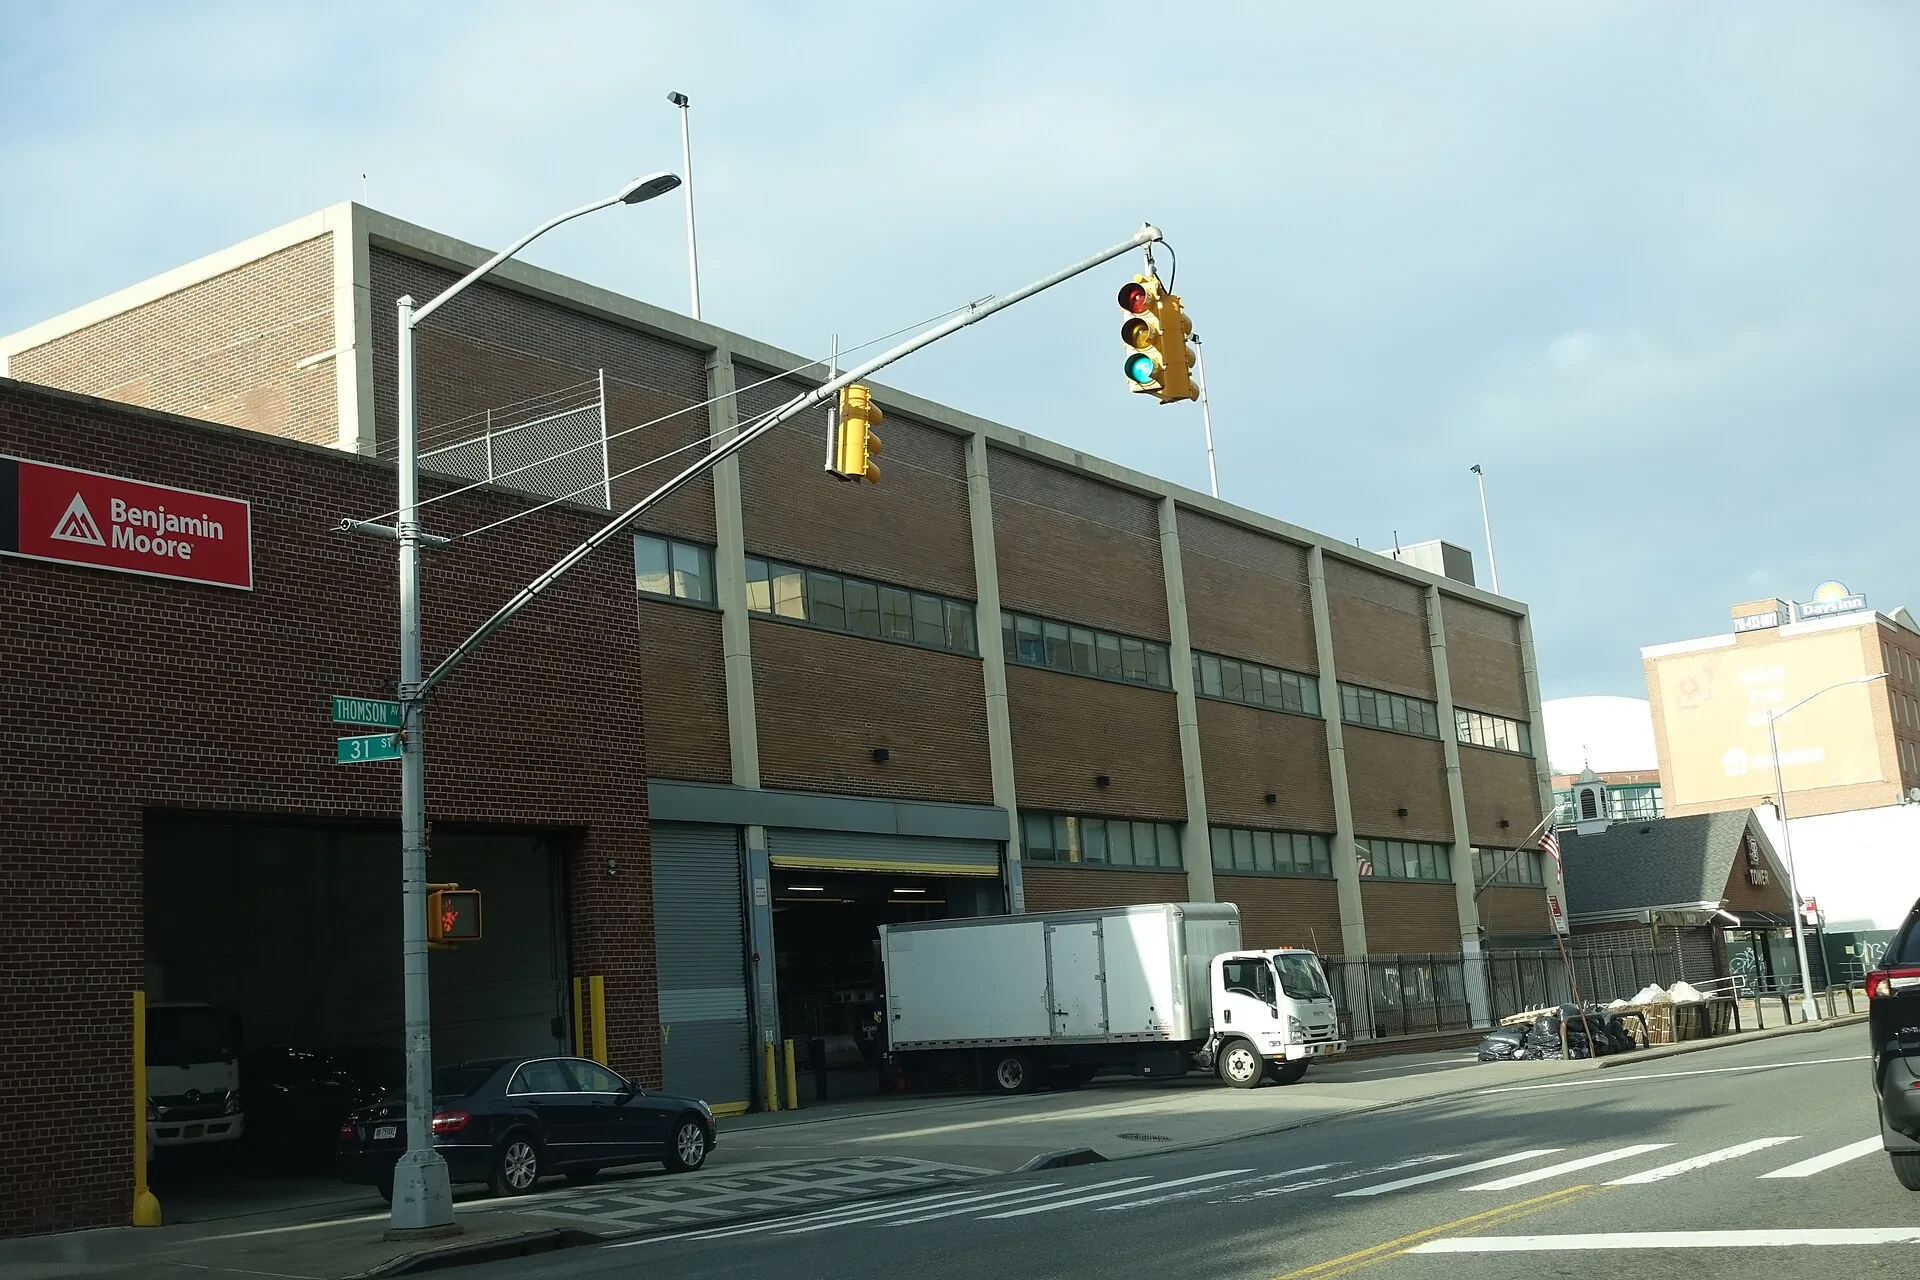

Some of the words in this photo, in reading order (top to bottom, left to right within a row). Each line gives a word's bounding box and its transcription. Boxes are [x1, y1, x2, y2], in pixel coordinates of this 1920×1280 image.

[110, 498, 224, 540] Benjamin
[111, 524, 192, 560] Moore
[336, 700, 387, 723] THOMSON
[350, 740, 369, 759] 31
[381, 737, 391, 748] ST
